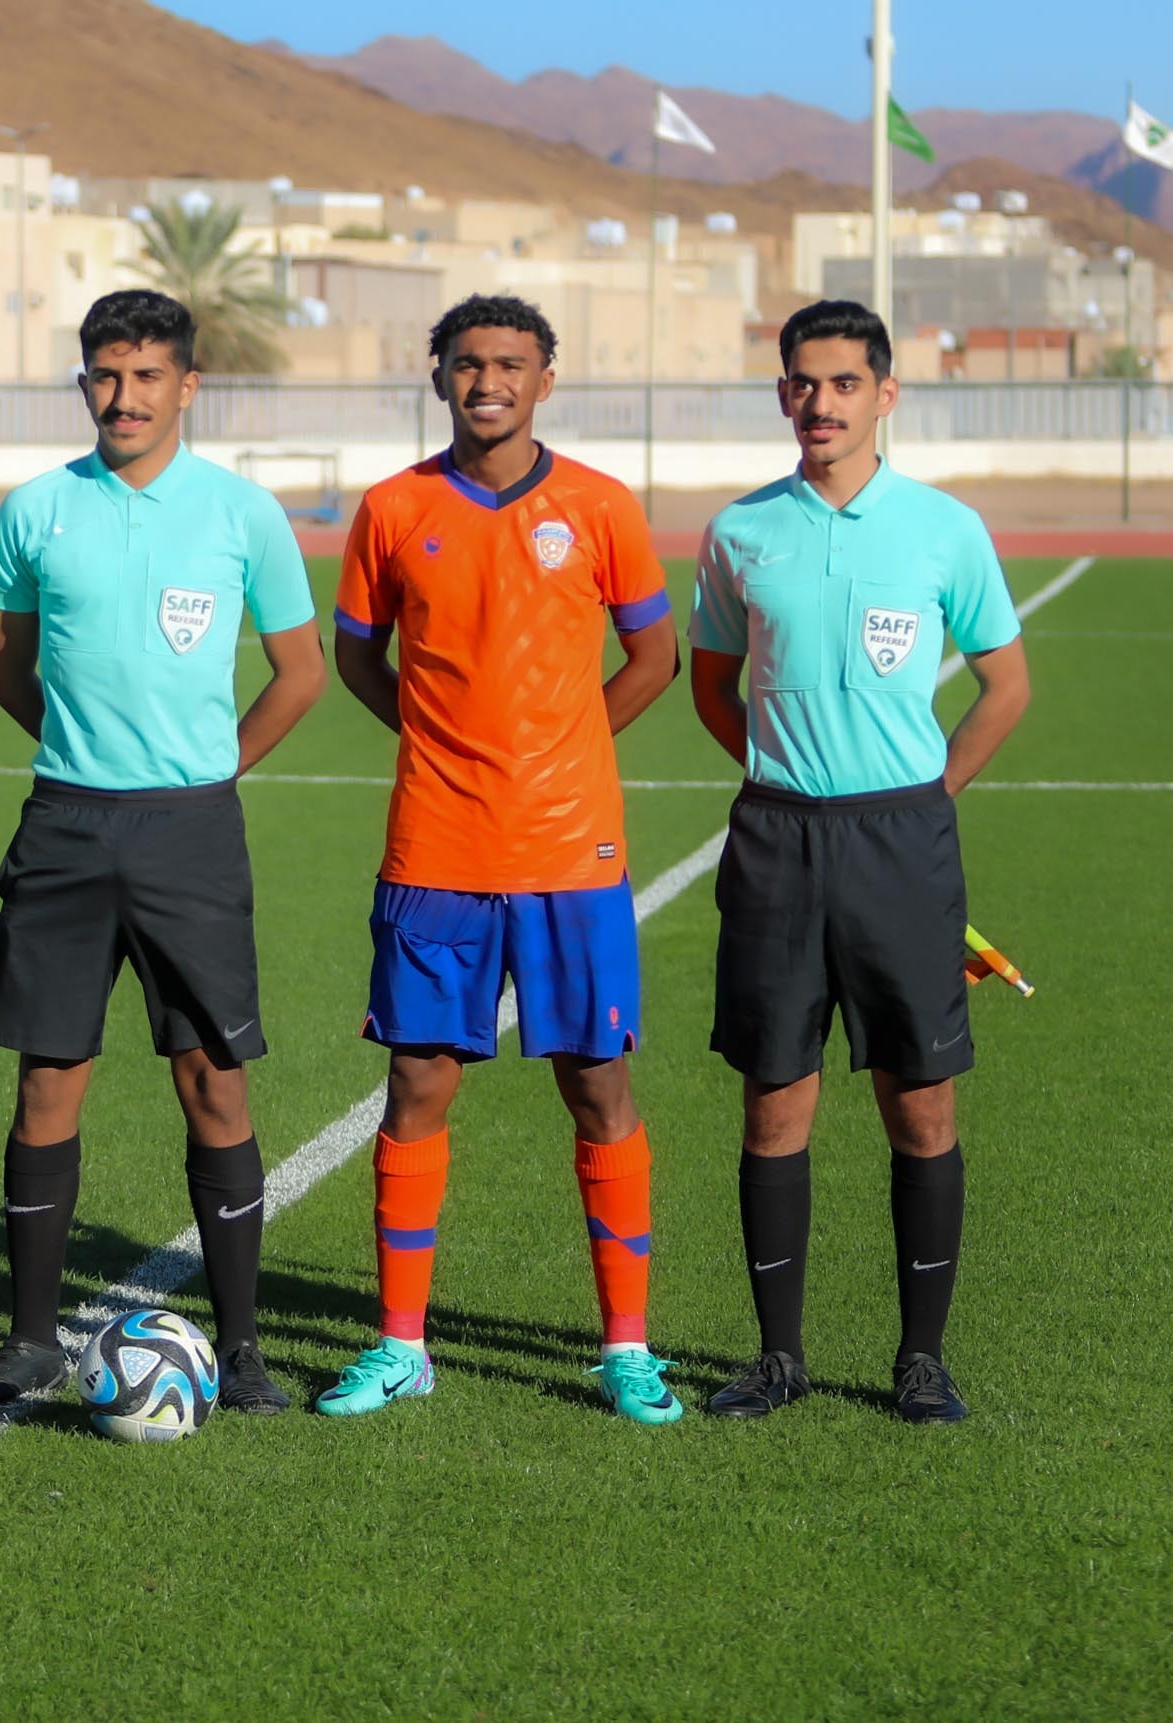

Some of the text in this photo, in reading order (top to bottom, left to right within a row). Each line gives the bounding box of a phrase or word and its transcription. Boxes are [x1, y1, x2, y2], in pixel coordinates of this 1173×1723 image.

[167, 595, 212, 615] SAFF
[868, 615, 915, 635] SAFF
[870, 634, 908, 647] REFEREE
